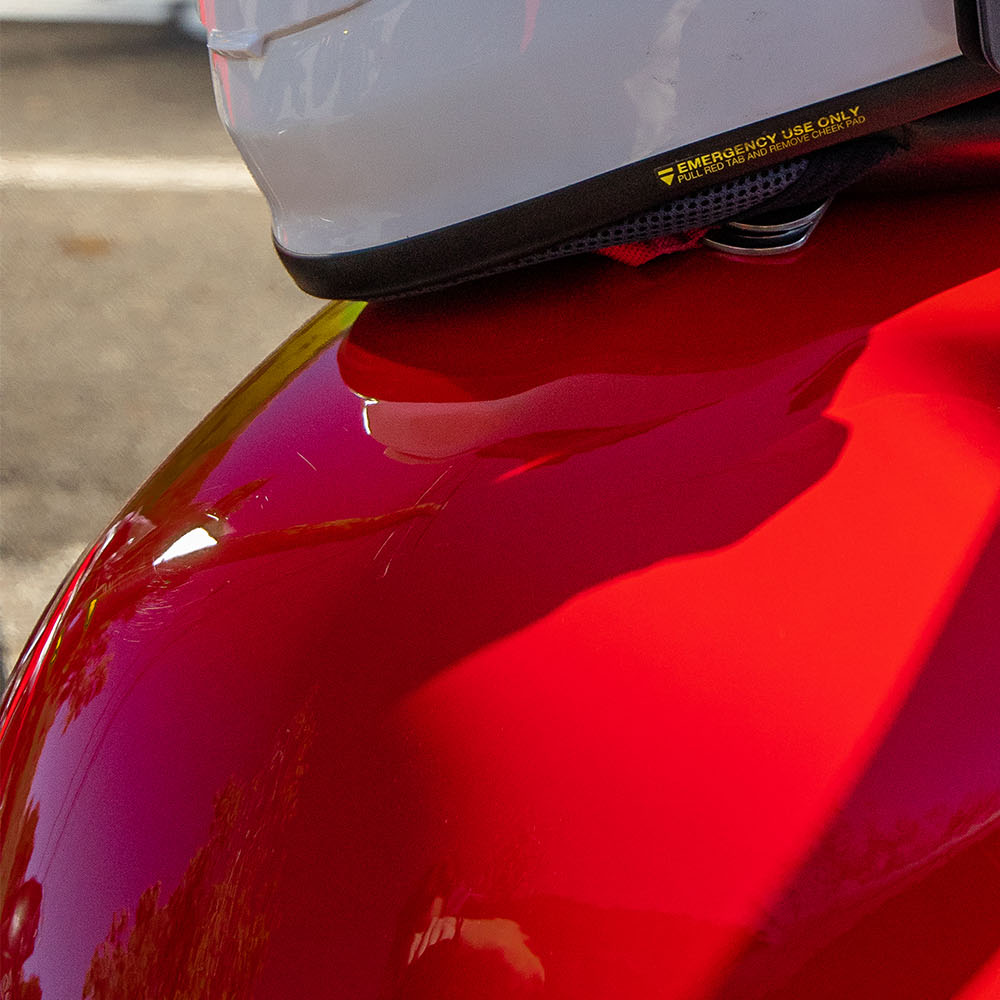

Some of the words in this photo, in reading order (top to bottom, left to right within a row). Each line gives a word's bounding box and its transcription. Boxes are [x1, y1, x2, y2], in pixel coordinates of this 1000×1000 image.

[677, 132, 777, 174] EMERGENCY
[781, 121, 815, 140] USE
[817, 105, 860, 128] ONLY
[677, 169, 704, 184] PULL
[703, 161, 725, 175] RED
[725, 154, 746, 167] TAB
[747, 147, 768, 161] AND
[769, 133, 810, 153] REMOVE
[811, 122, 845, 139] CHEEK
[845, 115, 866, 128] PAD
